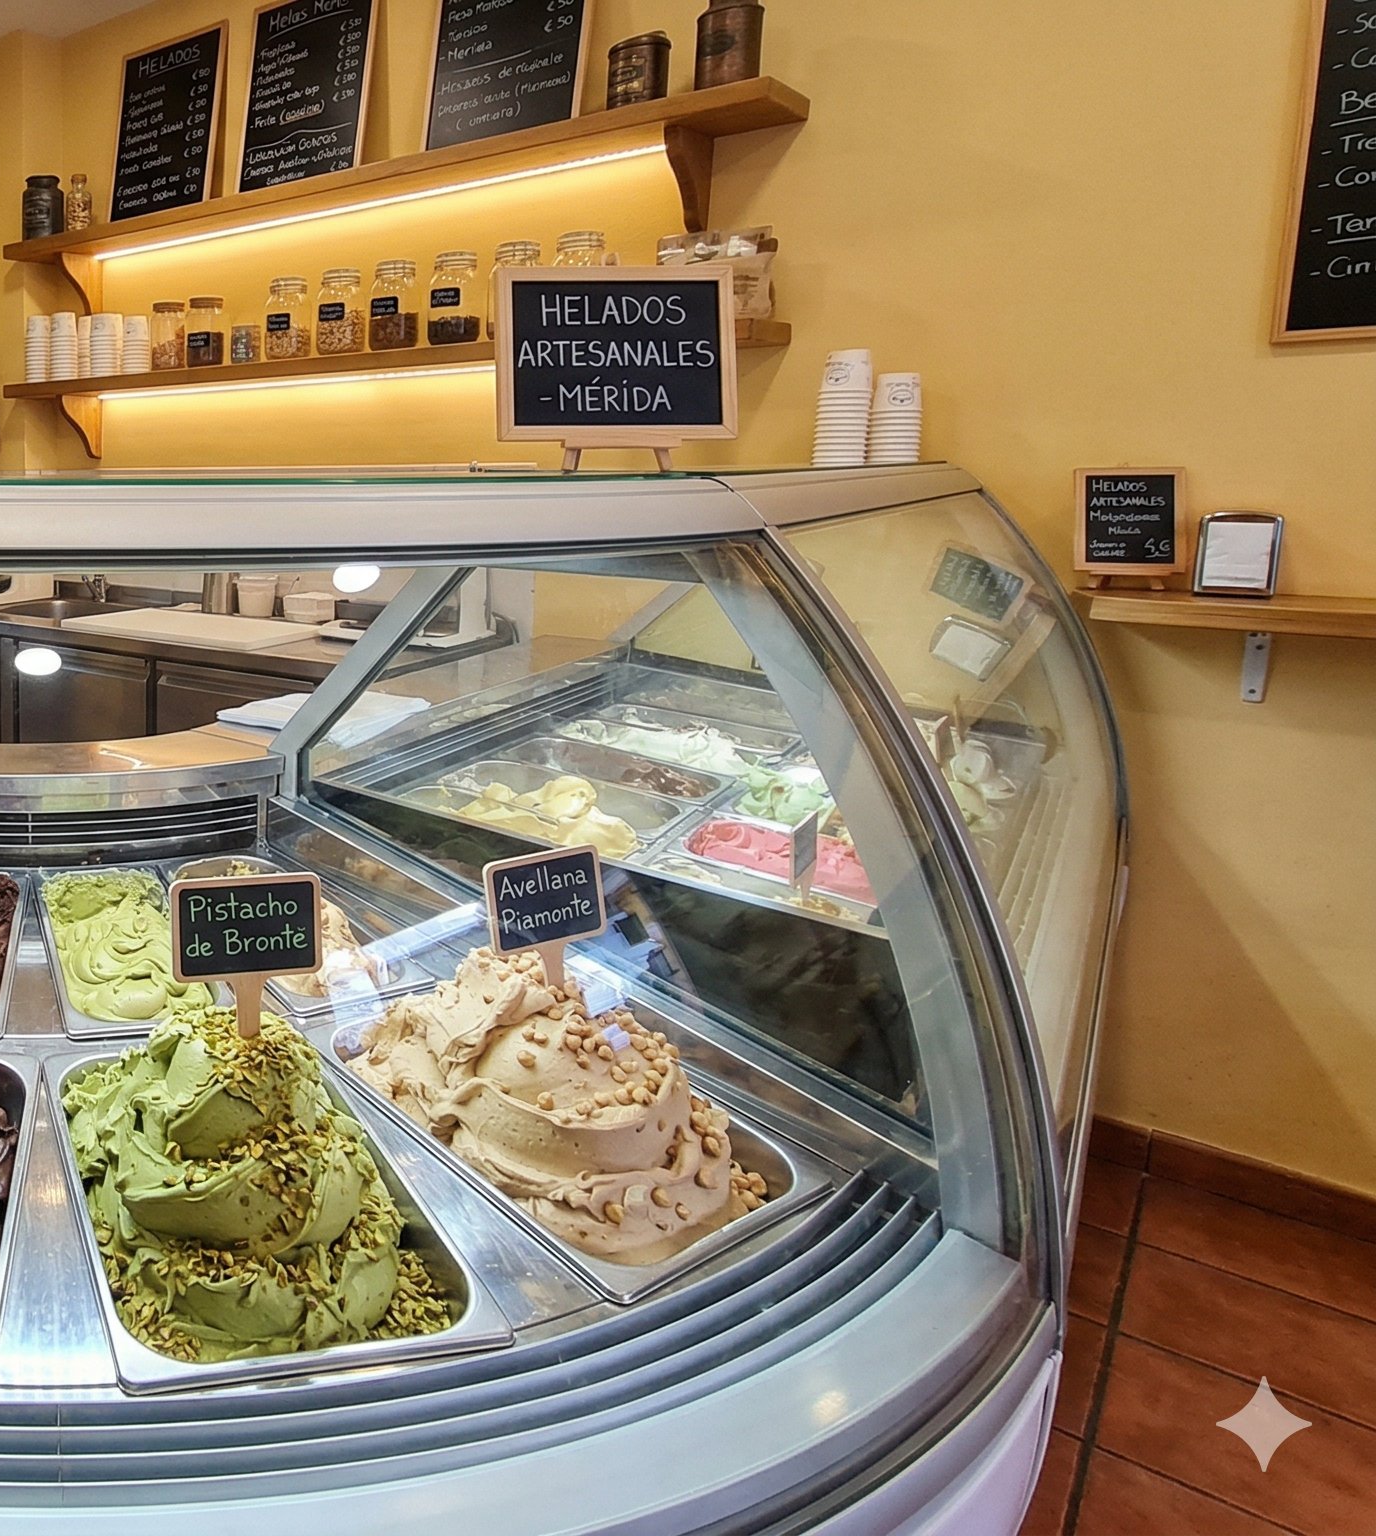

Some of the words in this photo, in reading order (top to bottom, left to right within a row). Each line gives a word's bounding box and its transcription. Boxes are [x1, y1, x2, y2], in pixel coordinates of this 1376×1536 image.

[138, 44, 201, 78] HELADOS
[540, 294, 686, 327] HELADOS
[517, 340, 715, 368] ARTESANALES
[1092, 479, 1148, 493] HELADOS
[499, 865, 589, 901] Avellana
[187, 892, 298, 923] Pistacho
[501, 893, 594, 935] Piamonte
[185, 933, 214, 958] de
